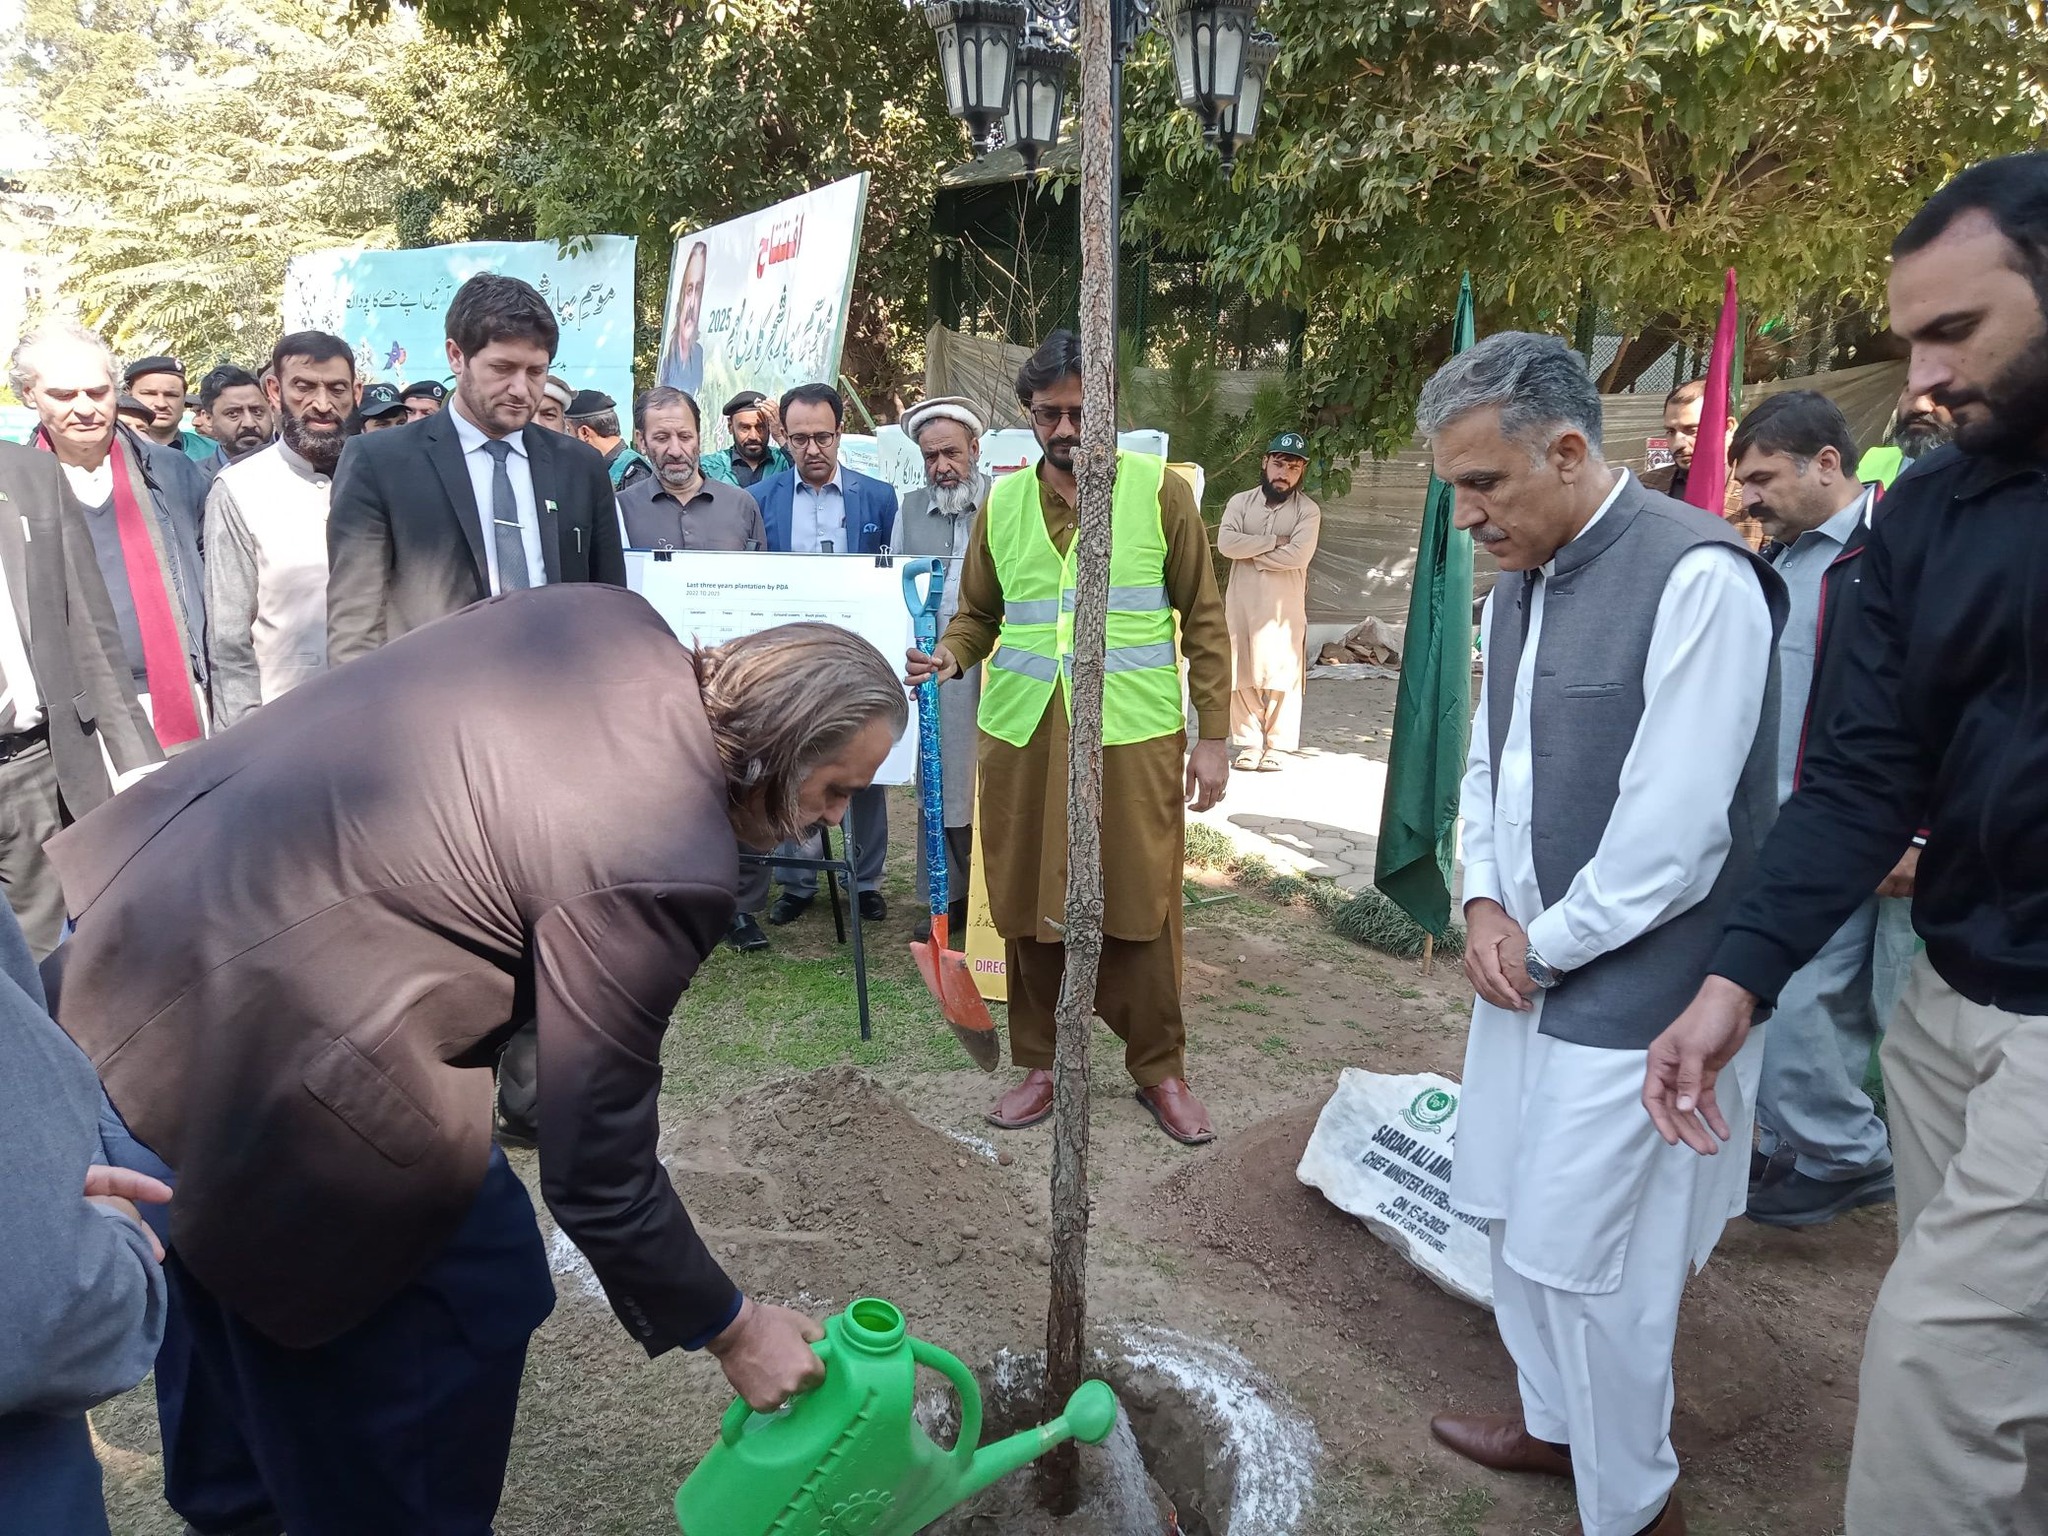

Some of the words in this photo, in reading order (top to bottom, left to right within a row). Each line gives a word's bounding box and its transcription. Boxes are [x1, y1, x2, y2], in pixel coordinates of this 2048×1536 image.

[757, 212, 804, 279] افتتاح
[708, 307, 733, 333] 2025
[1372, 1124, 1418, 1158] SARDAR
[1407, 1145, 1436, 1168] ALI
[1362, 1150, 1391, 1172] CHIEF
[1382, 1162, 1425, 1194] MINISTER
[1376, 1202, 1402, 1222] PLANT
[1399, 1217, 1418, 1233] FOR
[1415, 1228, 1448, 1254] FUTURE
[1392, 1196, 1411, 1212] ON
[1407, 1204, 1451, 1236] 15-2-2025
